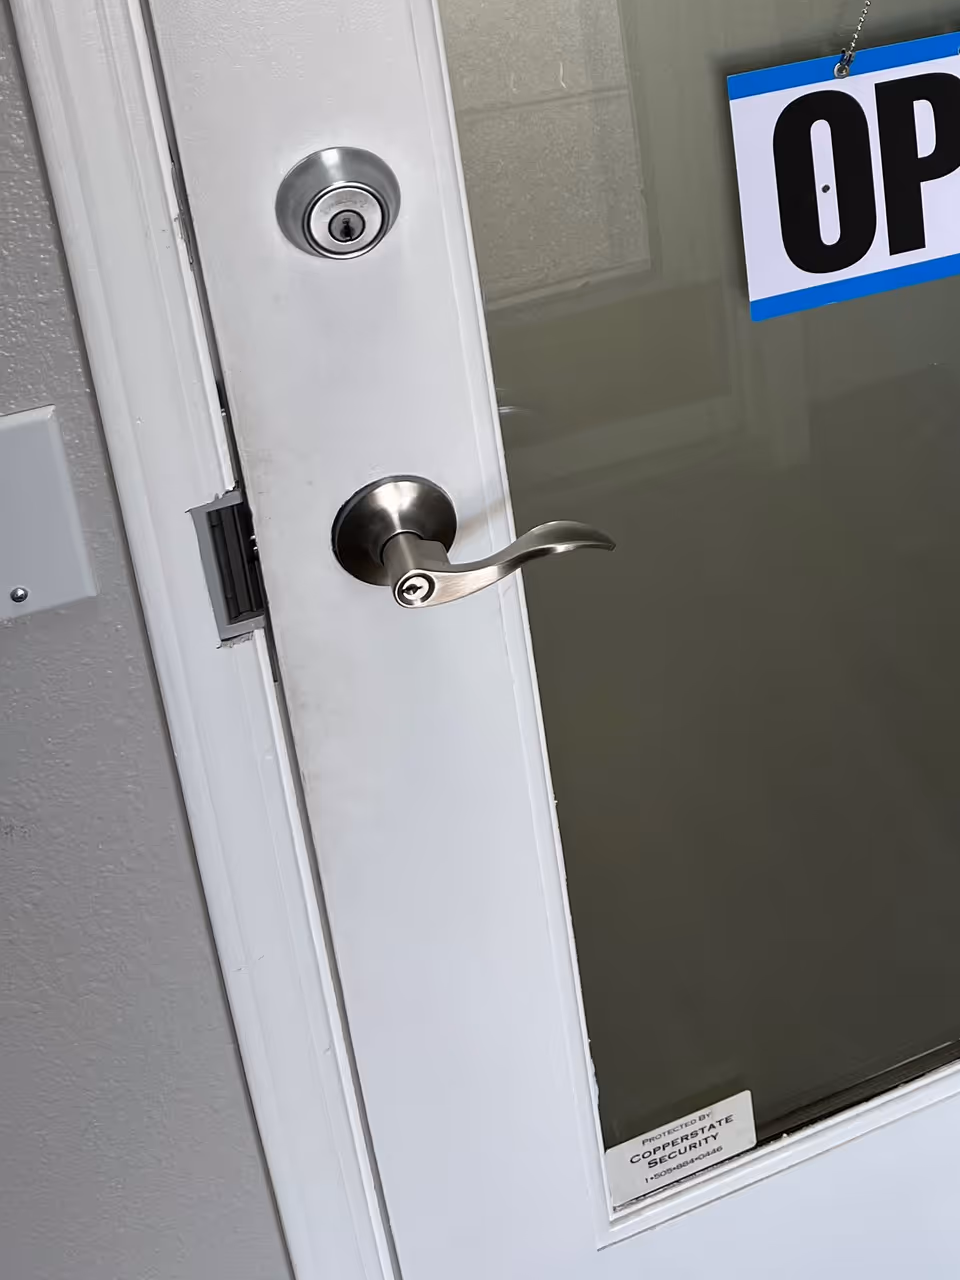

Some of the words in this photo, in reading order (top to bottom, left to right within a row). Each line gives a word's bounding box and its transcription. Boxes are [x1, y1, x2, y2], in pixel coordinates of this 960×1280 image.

[629, 1113, 734, 1165] COPPERSTATE
[641, 1118, 697, 1146] PROTECTED
[647, 1132, 720, 1169] SECURITY
